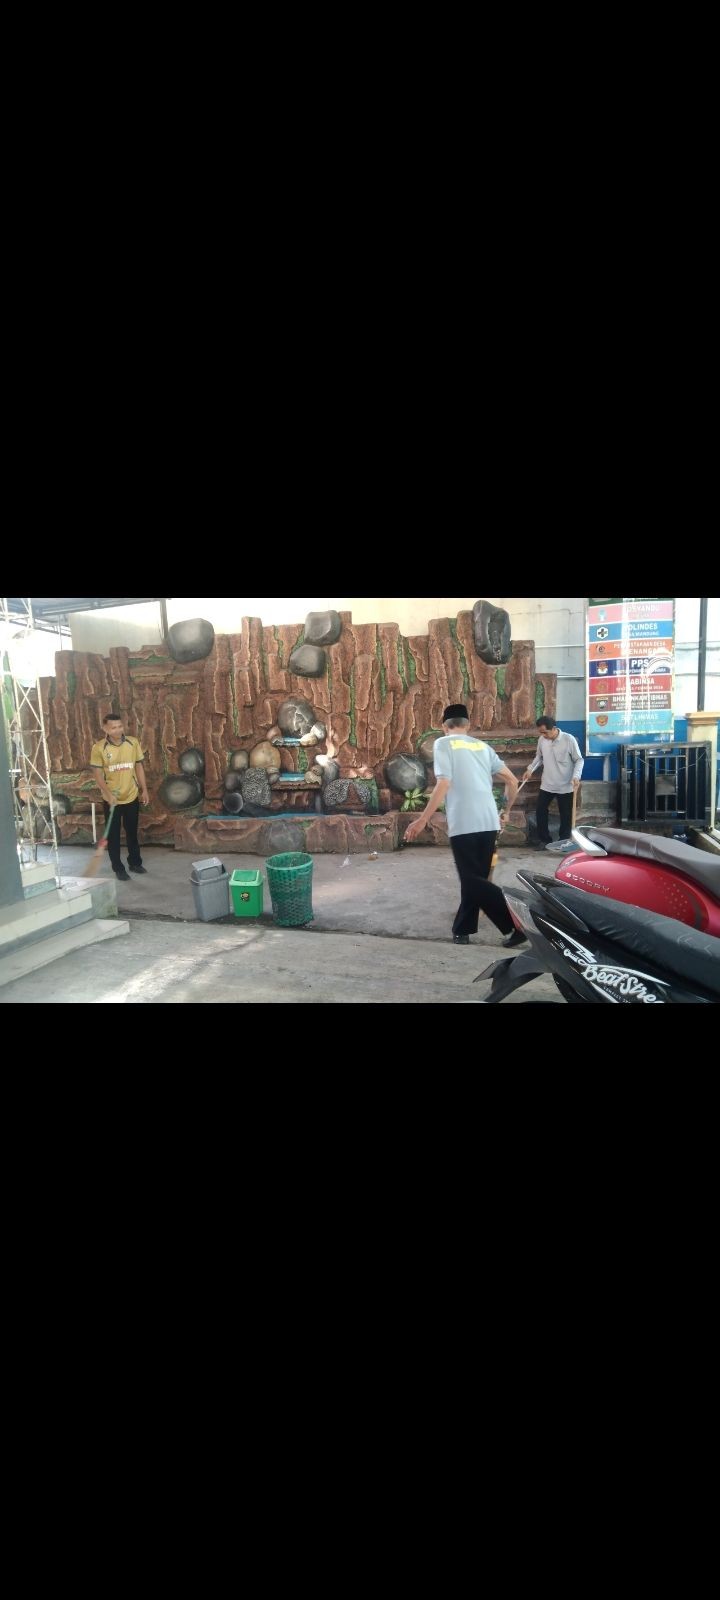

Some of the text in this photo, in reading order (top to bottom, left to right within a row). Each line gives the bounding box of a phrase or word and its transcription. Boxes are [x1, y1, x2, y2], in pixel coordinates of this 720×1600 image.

[625, 623, 658, 632] OLINDES
[631, 659, 649, 669] PPS
[627, 677, 655, 686] ABINSA
